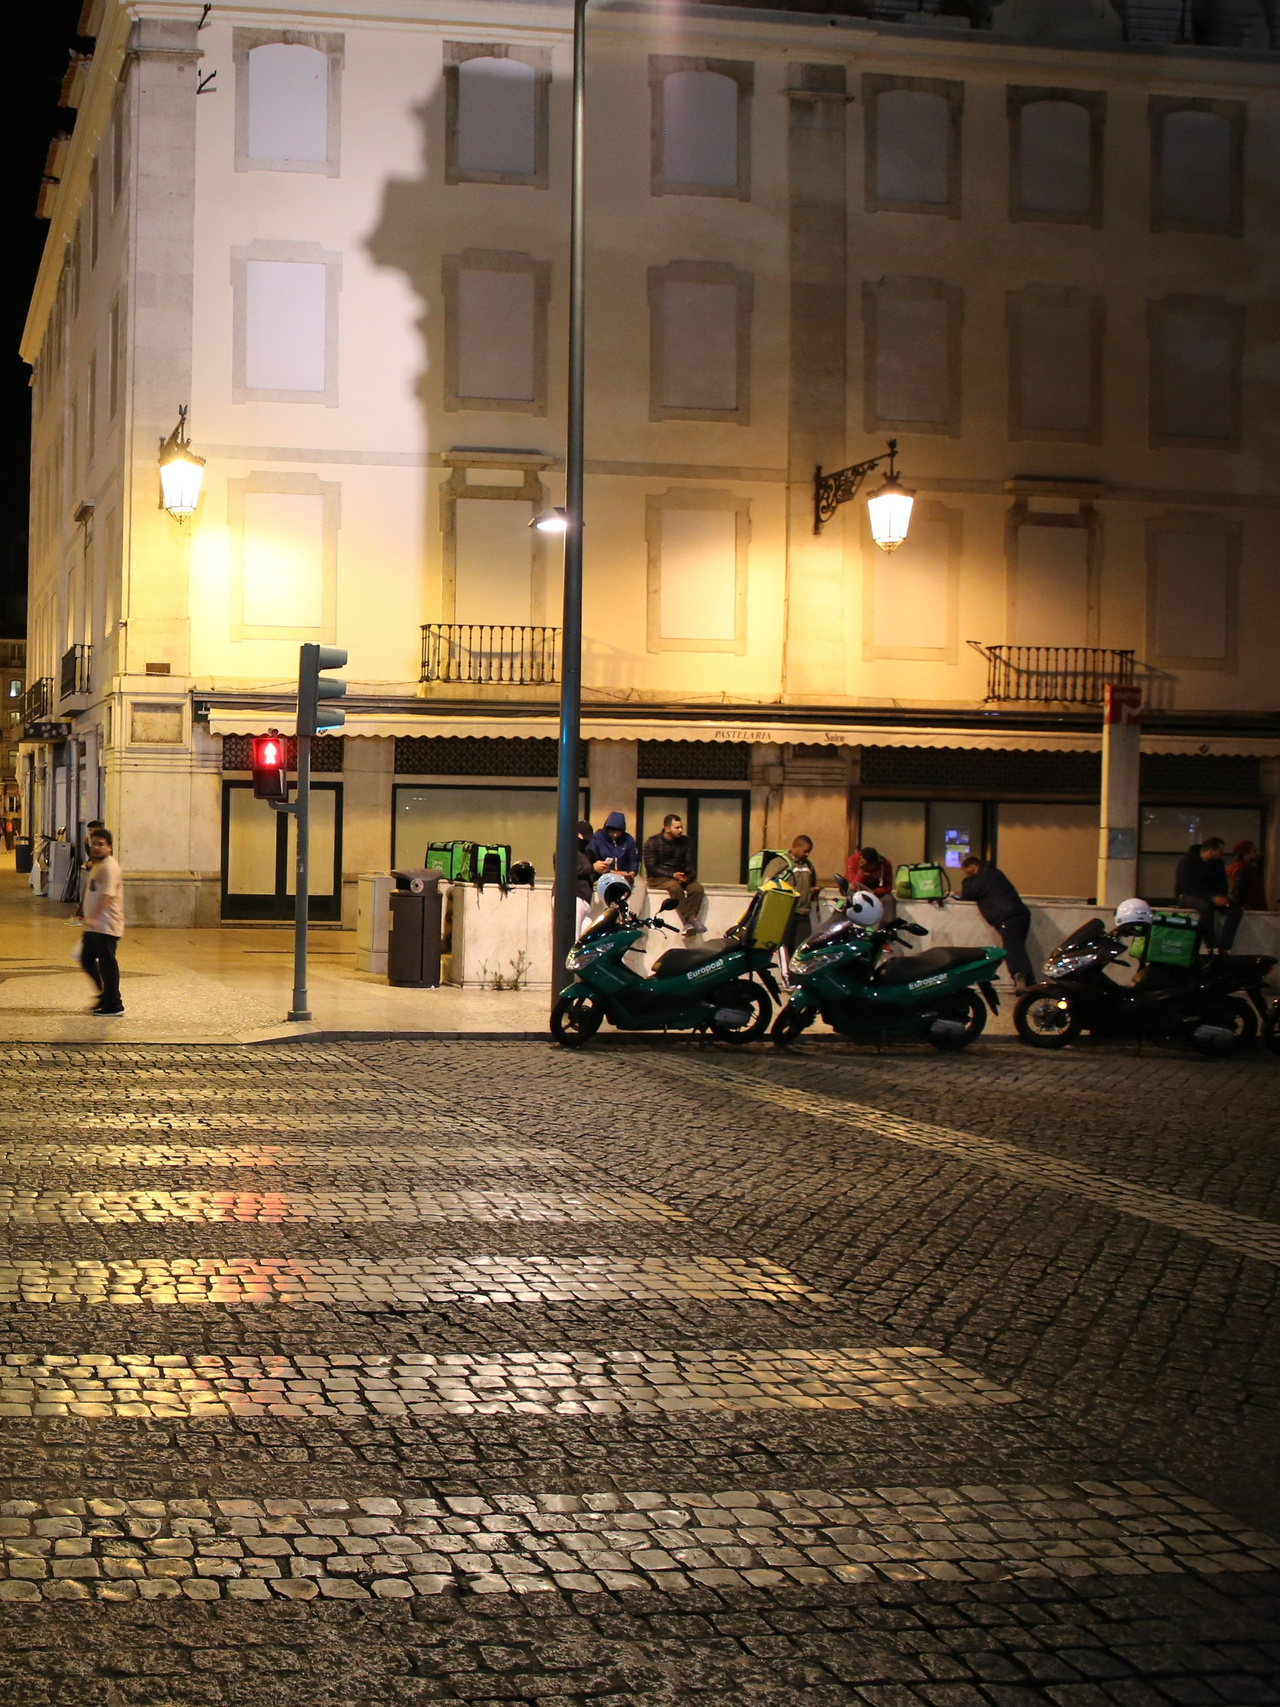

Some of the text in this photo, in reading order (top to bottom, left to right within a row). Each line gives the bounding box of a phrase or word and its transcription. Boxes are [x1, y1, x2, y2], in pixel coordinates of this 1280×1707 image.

[714, 730, 772, 740] PASTELARIA
[686, 958, 724, 980] Europcar
[908, 972, 948, 990] Europcar
